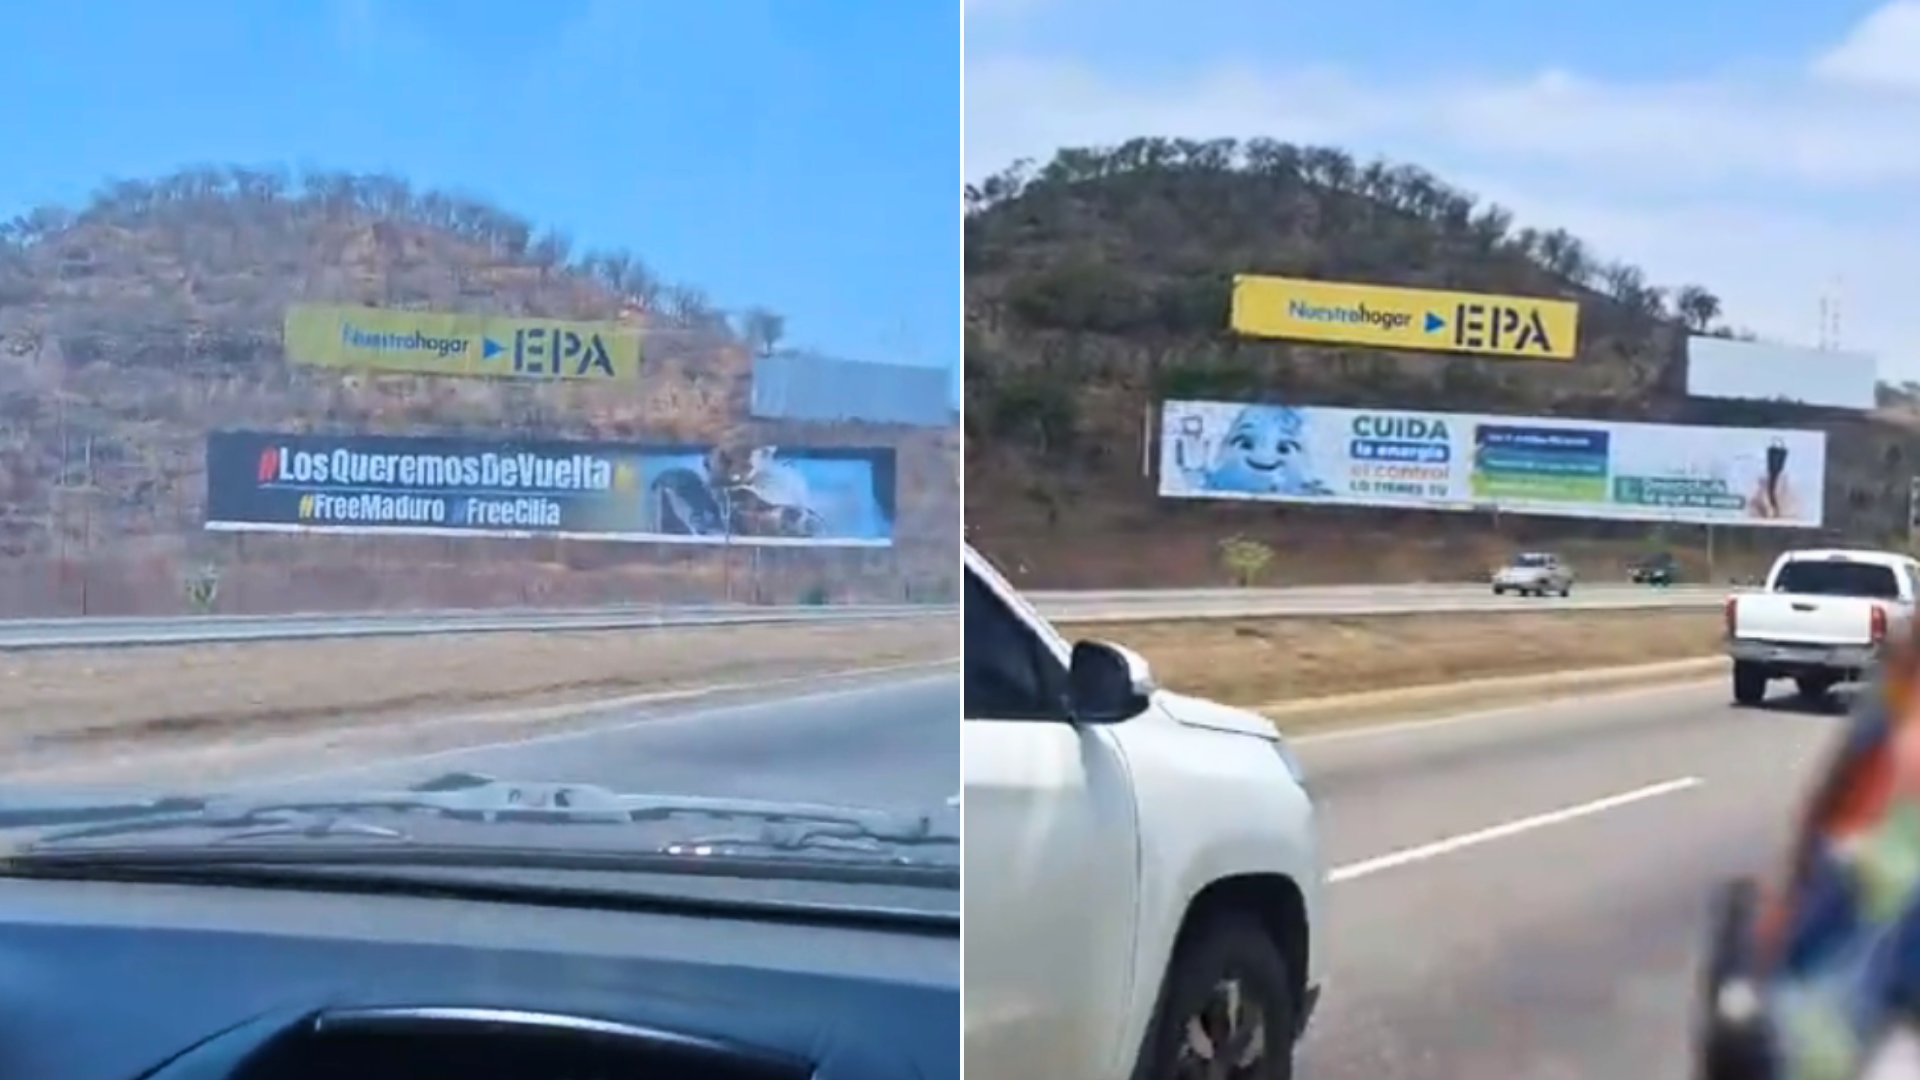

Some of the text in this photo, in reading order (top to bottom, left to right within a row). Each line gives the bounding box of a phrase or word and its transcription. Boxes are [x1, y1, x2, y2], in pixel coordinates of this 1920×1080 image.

[1288, 299, 1551, 353] Nuestrohogar EPA
[514, 328, 615, 376] EPA
[1352, 414, 1450, 441] CUIDA
[257, 447, 611, 490] #LosQueremosDeVuelta
[299, 494, 446, 523] #FreeMaduro
